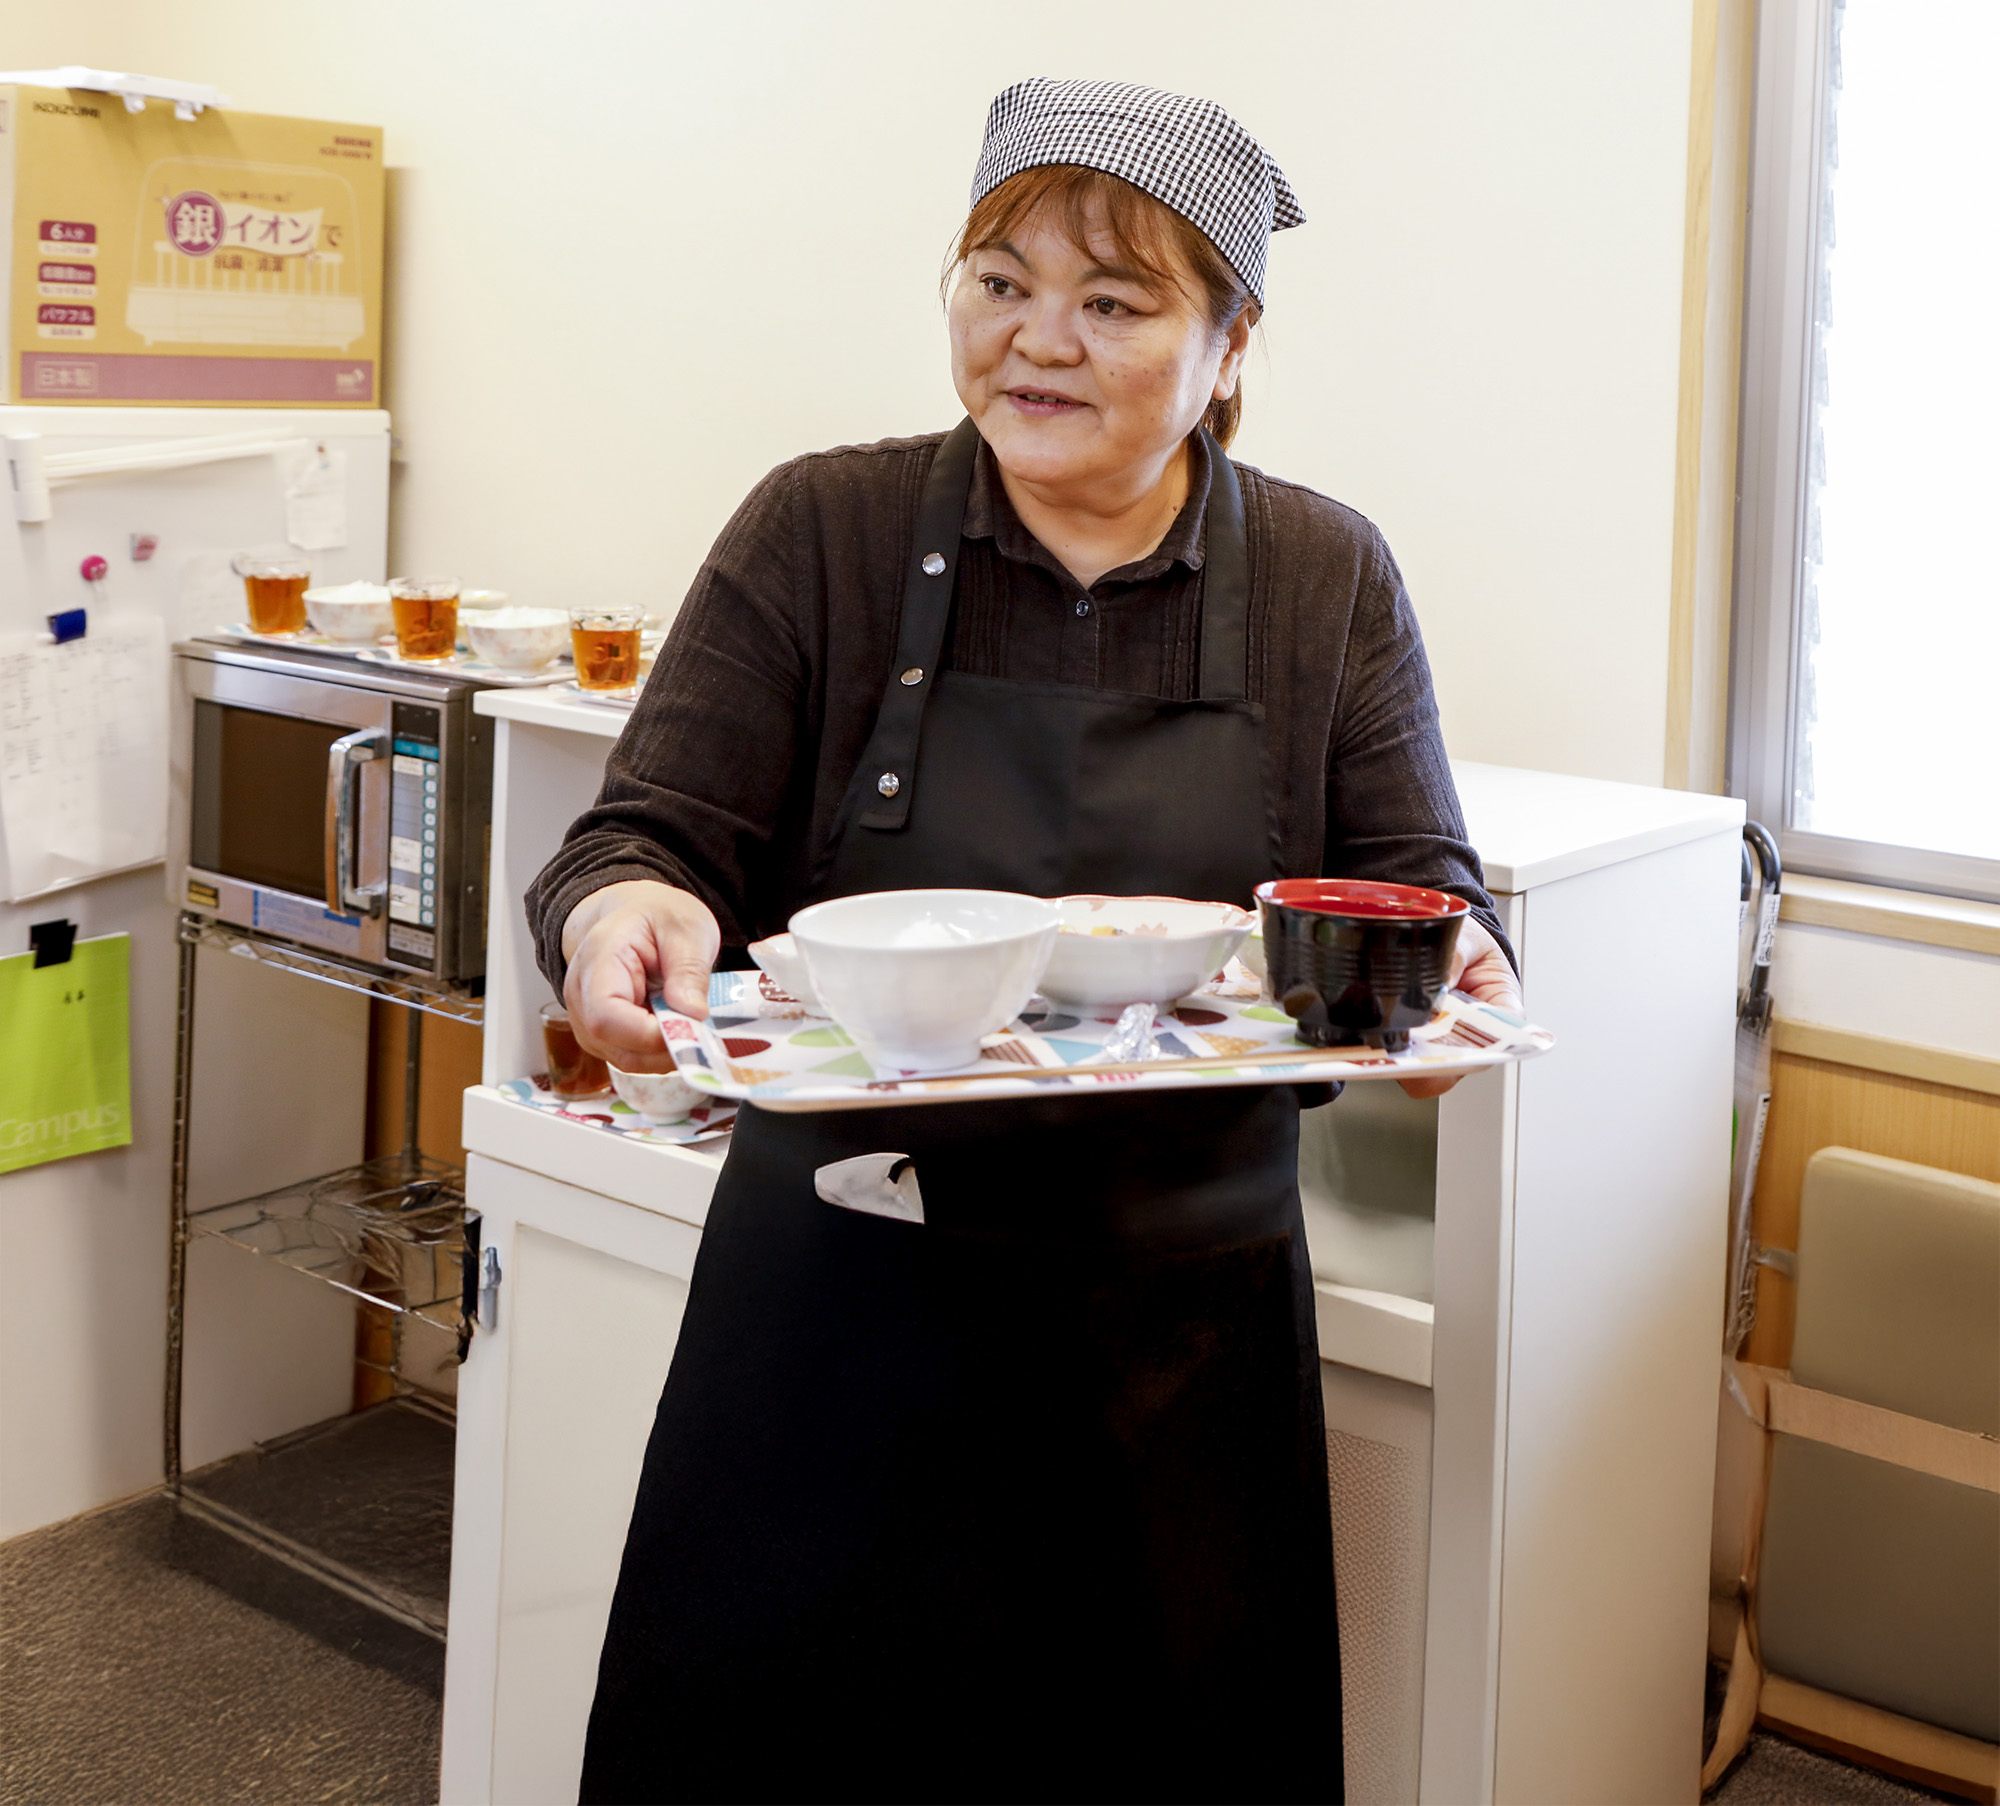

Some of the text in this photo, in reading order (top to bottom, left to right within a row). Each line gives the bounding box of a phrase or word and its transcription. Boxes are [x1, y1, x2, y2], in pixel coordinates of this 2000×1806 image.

[39, 367, 91, 387] 日本製
[0, 1102, 120, 1150] Campus
